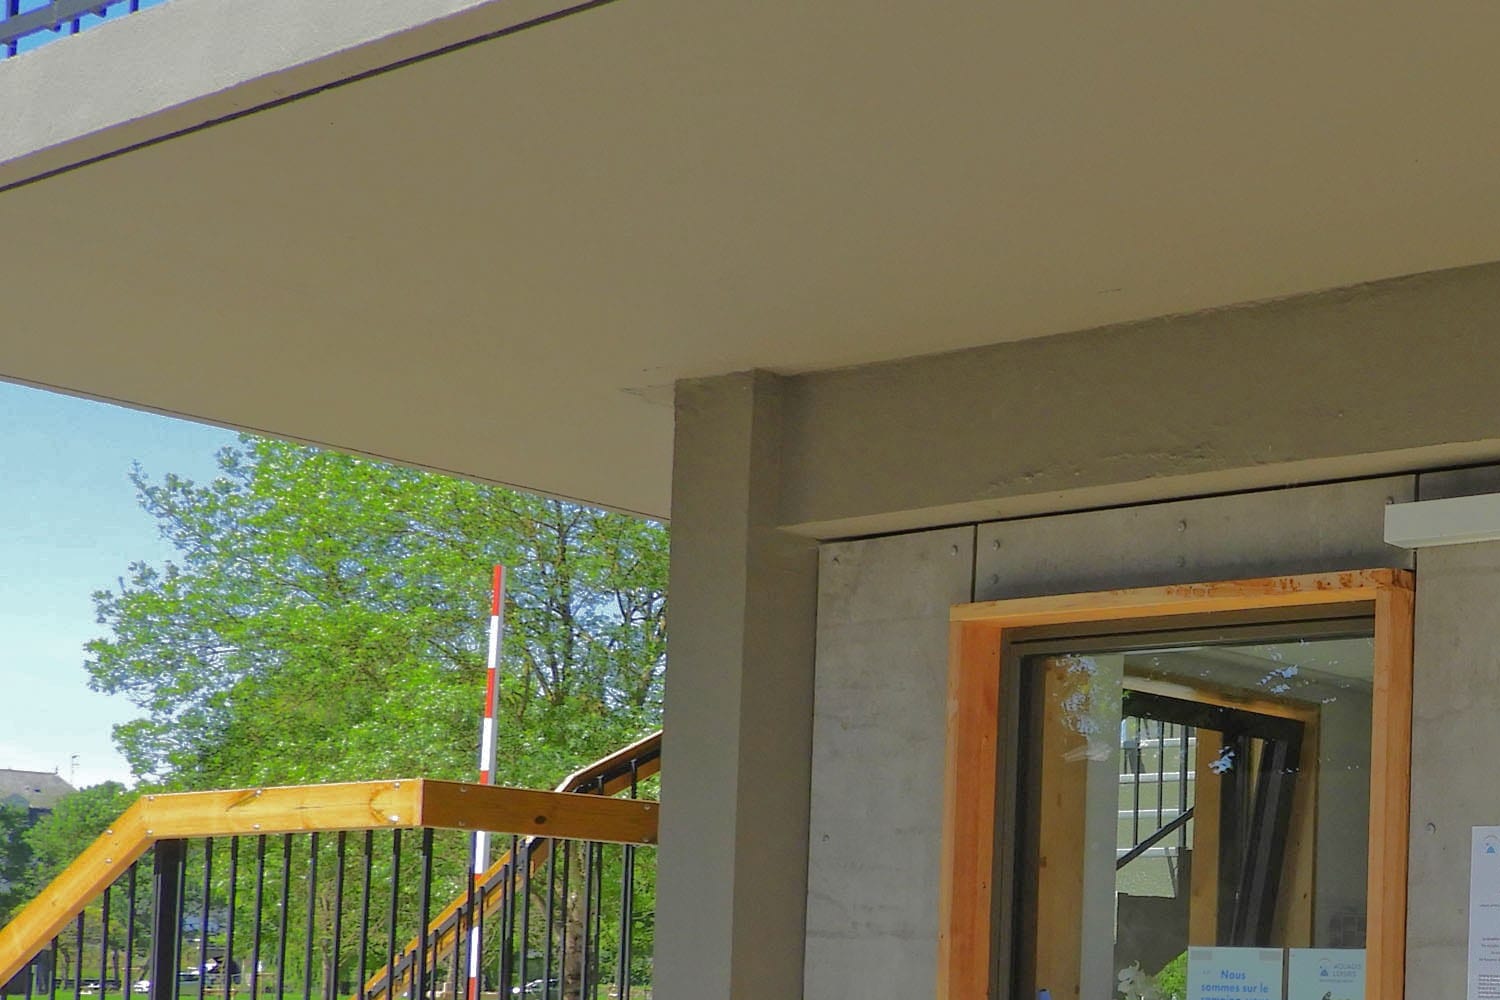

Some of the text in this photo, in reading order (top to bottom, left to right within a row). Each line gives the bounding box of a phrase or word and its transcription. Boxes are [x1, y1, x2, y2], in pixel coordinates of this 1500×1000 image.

[1220, 969, 1246, 980] Nous
[1201, 982, 1269, 993] sommes sur le
